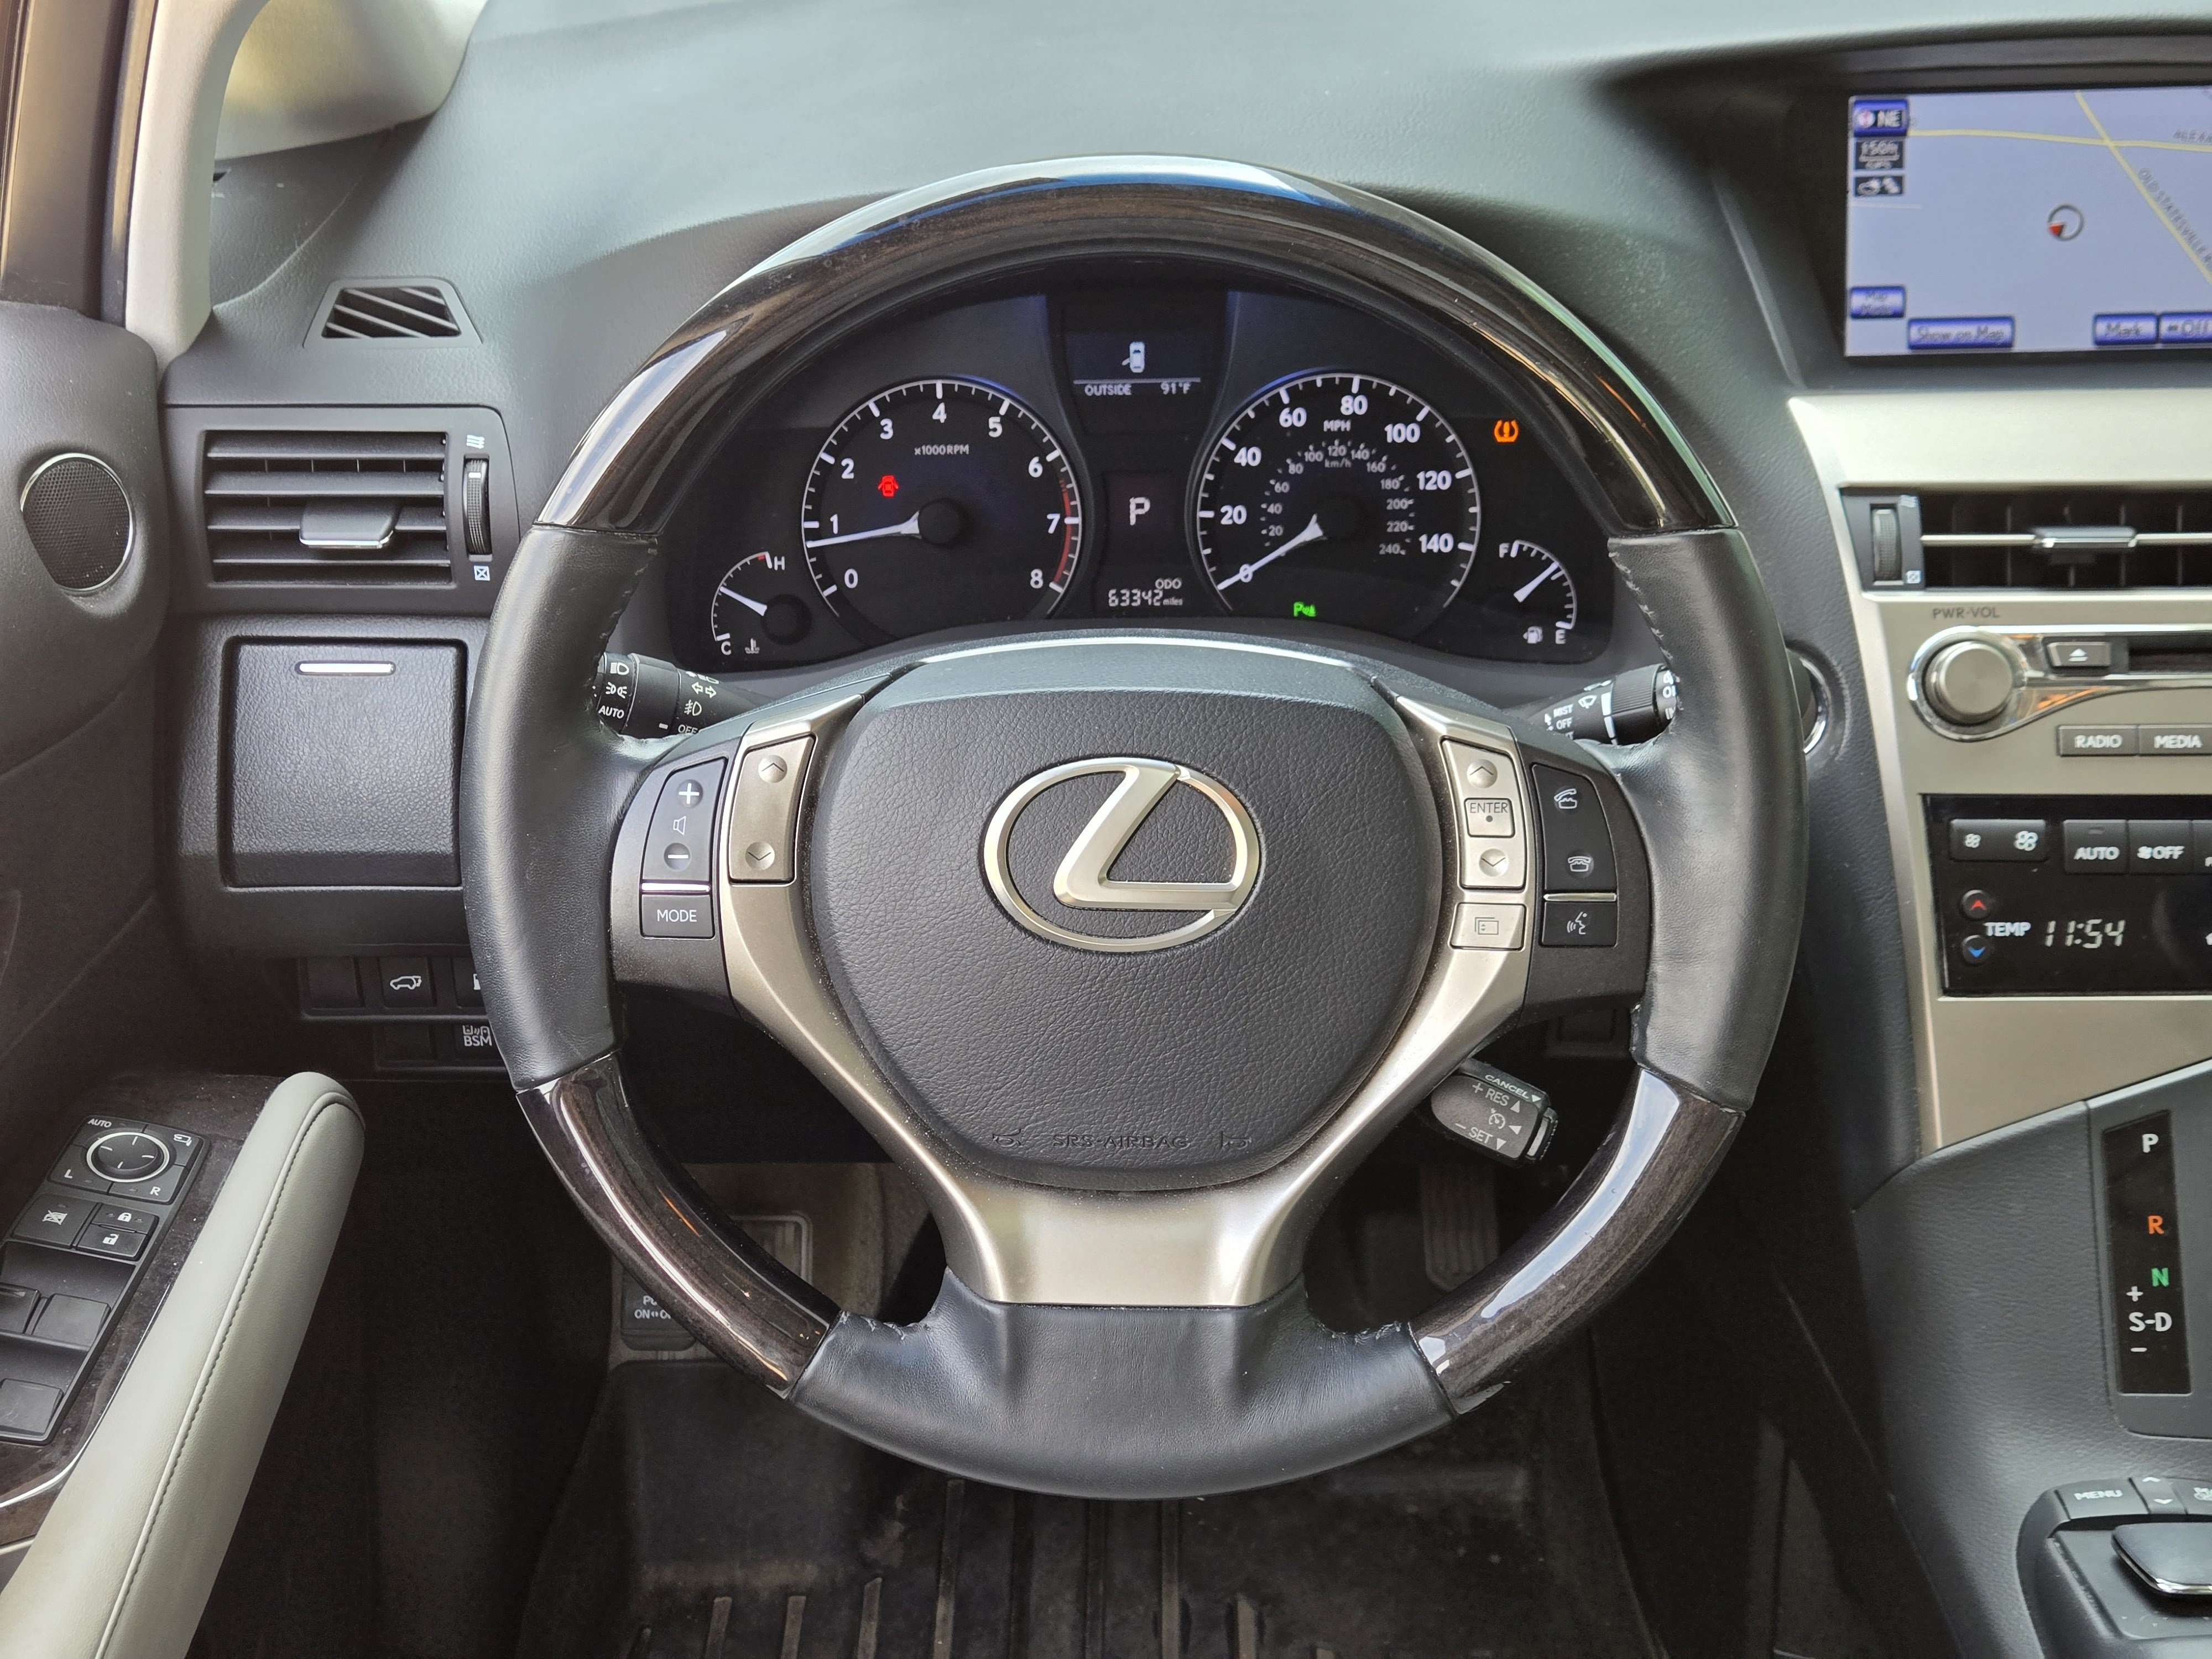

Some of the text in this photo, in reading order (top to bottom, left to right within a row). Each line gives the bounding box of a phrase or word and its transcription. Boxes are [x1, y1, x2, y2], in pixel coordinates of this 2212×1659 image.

[1877, 109, 1902, 128] NE
[1084, 383, 1132, 396] OUTSIDE
[1340, 395, 1368, 415] 80
[933, 403, 946, 422] 4
[1279, 408, 1307, 427] 60
[880, 419, 894, 439] 3
[989, 418, 1002, 437] 5
[1323, 420, 1352, 432] MPH
[1384, 423, 1421, 443] 100
[1234, 447, 1262, 467] 40
[1304, 450, 1324, 462] 100
[1328, 445, 1348, 457] 120
[1351, 448, 1371, 461] 140
[841, 459, 855, 479] 2
[1029, 457, 1044, 477] 6
[1288, 462, 1305, 474] 80
[1324, 457, 1352, 468] km/h
[1366, 461, 1386, 473] 160
[1274, 481, 1290, 493] 60
[1380, 478, 1400, 490] 180
[1416, 471, 1452, 491] 120
[1129, 497, 1151, 525] P
[1267, 502, 1283, 514] 40
[1386, 498, 1408, 510] 200
[1220, 505, 1246, 525] 20
[830, 514, 838, 534] 1
[1047, 514, 1060, 533] 7
[1269, 525, 1284, 536] 20
[1386, 520, 1408, 532] 220
[1379, 542, 1401, 555] 240
[1419, 533, 1454, 553] 140
[1499, 544, 1510, 558] F
[774, 557, 785, 570] H
[844, 570, 858, 588] 0
[1030, 570, 1044, 589] 8
[1155, 578, 1182, 589] ODO
[1108, 588, 1183, 607] 63342 miles
[1555, 630, 1566, 644] E
[721, 641, 732, 655] C
[598, 705, 625, 719] AUTO
[1553, 704, 1574, 717] MIST
[677, 724, 698, 734] OFF
[1556, 717, 1573, 731] OFF
[2074, 734, 2122, 749] RADIO
[2154, 734, 2202, 749] MEDIA
[1469, 802, 1509, 814] ENTER
[2074, 846, 2120, 860] AUTO
[2151, 846, 2185, 859] OFF
[656, 909, 698, 922] MODE
[1984, 922, 2031, 937] TEMP
[2045, 919, 2126, 948] 11:54
[463, 1035, 492, 1046] BSM
[1484, 1074, 1530, 1099] CANCEL
[1485, 1088, 1510, 1107] RES
[87, 1118, 112, 1128] AUTO
[1468, 1126, 1493, 1145] SET
[2142, 1133, 2159, 1153] P
[64, 1169, 73, 1179] L
[150, 1186, 160, 1196] R
[2147, 1215, 2164, 1234] R
[2151, 1267, 2169, 1287] N
[2128, 1312, 2172, 1332] S-D
[2073, 1489, 2124, 1500] MENU
